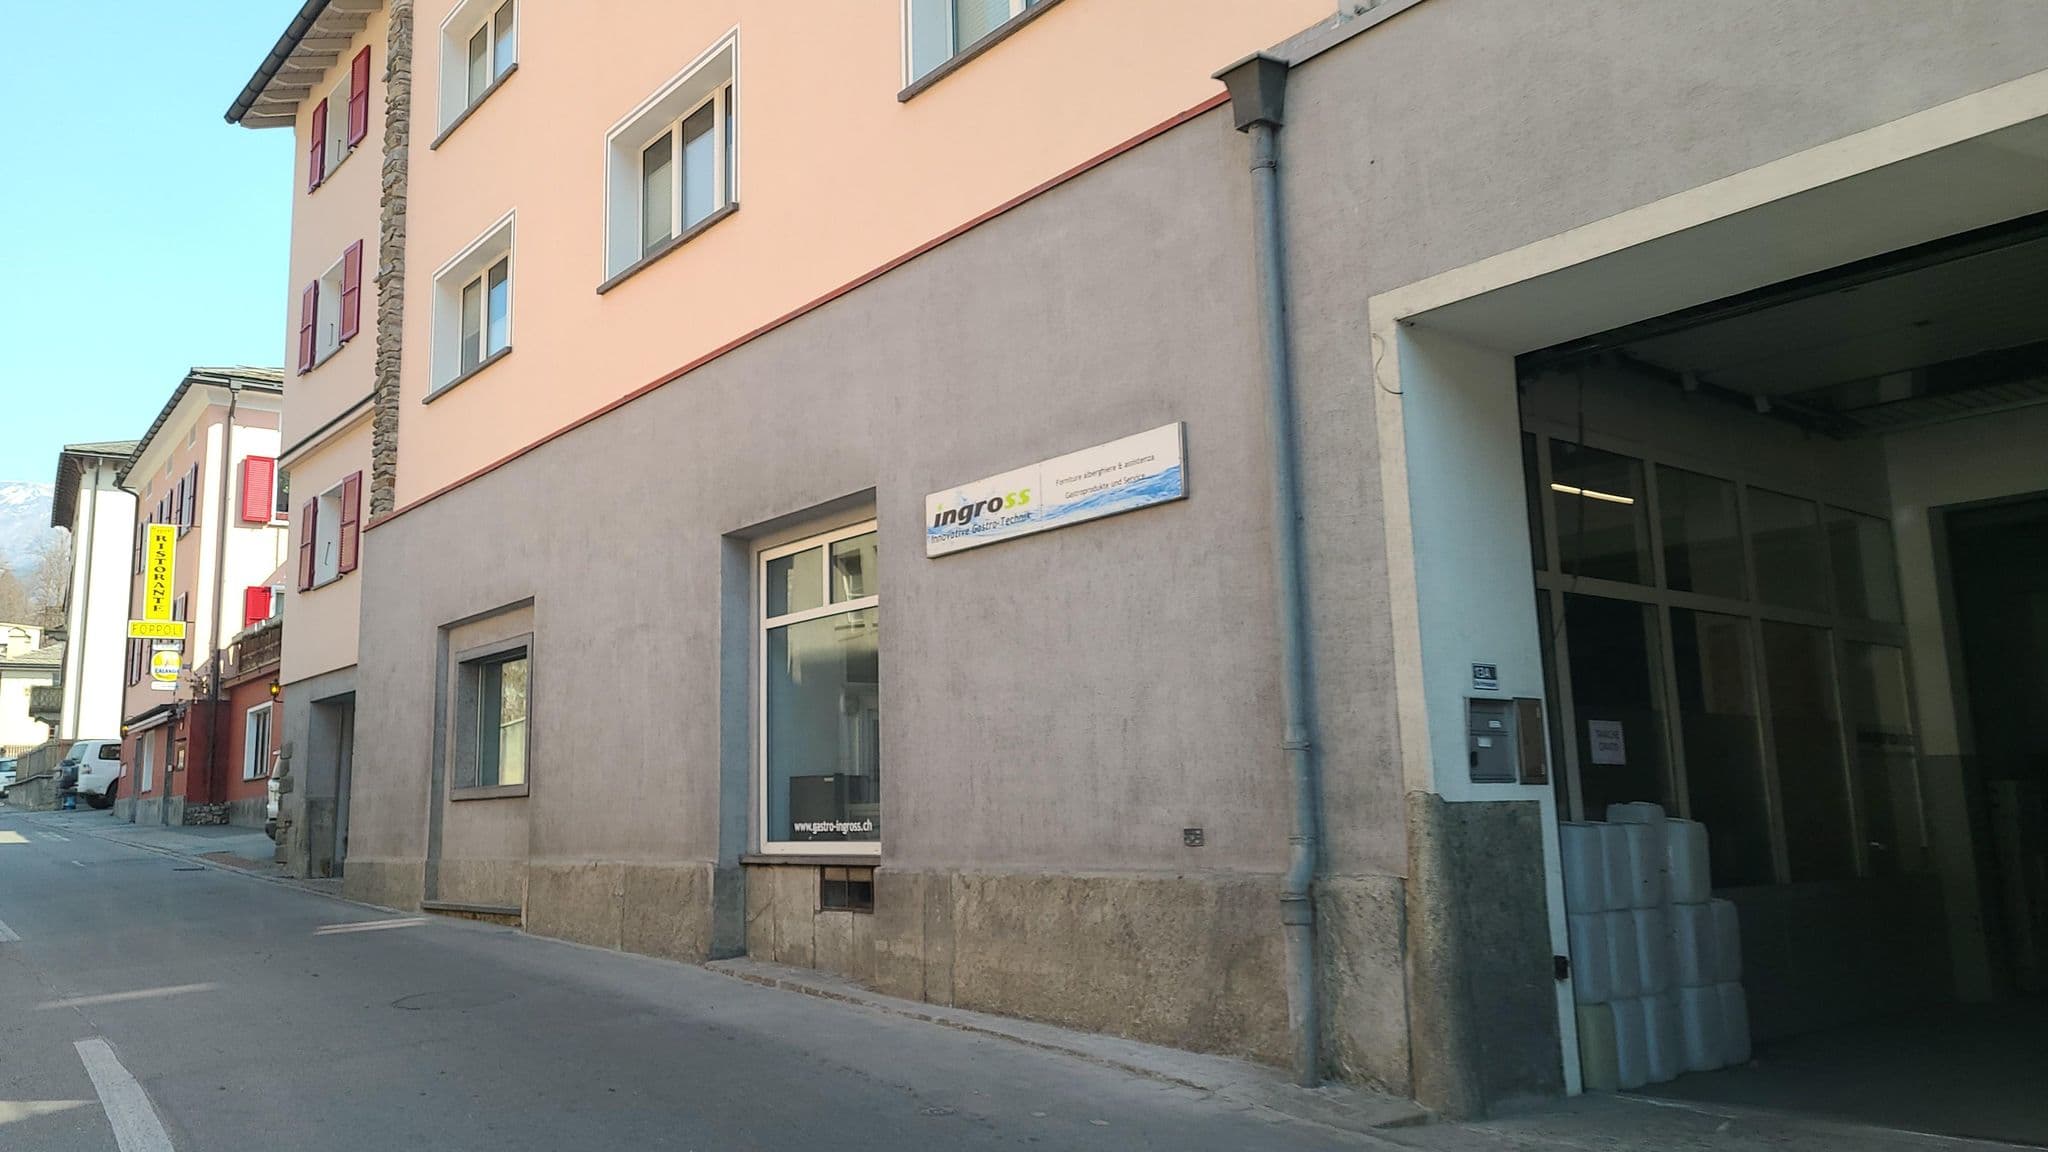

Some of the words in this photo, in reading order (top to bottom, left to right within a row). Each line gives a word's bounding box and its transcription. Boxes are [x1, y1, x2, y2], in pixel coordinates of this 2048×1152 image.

[1110, 478, 1122, 488] und
[1123, 472, 1145, 484] Service
[934, 488, 1031, 528] ingross
[930, 528, 970, 544] Innovative
[971, 511, 1033, 534] Gastro-Technik
[153, 535, 167, 612] RISTORANTE
[793, 818, 873, 835] www.gastro-ingross.ch
